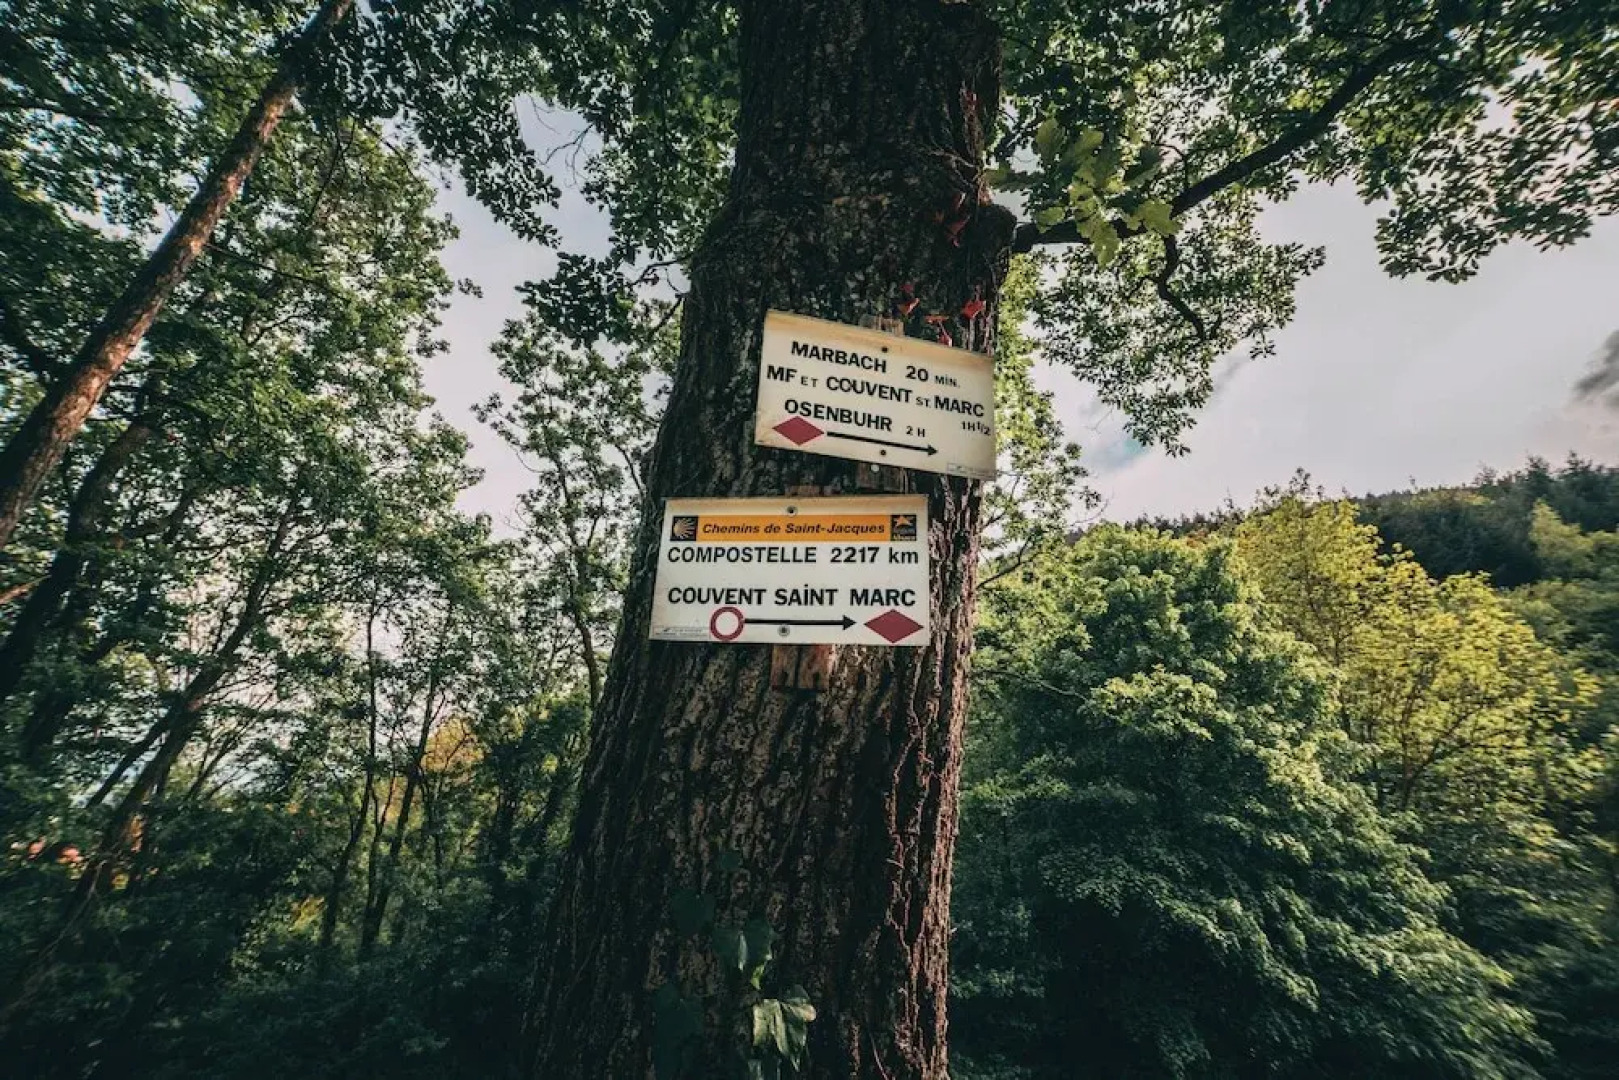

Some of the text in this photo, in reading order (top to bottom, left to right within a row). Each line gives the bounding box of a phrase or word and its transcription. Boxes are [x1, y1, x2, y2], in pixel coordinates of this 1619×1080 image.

[791, 341, 886, 373] MARBACH
[906, 366, 928, 382] 20
[767, 365, 797, 383] MF
[801, 376, 818, 387] ET
[826, 376, 912, 403] COUVENT
[934, 395, 985, 417] MARC
[785, 400, 926, 438] OSENBUHR 2 H
[702, 523, 885, 536] Chemins de Saint-Jacques
[668, 547, 918, 563] COMPOSTELLE 2217 km
[668, 588, 767, 605] COUVENT
[850, 589, 916, 606] MARC
